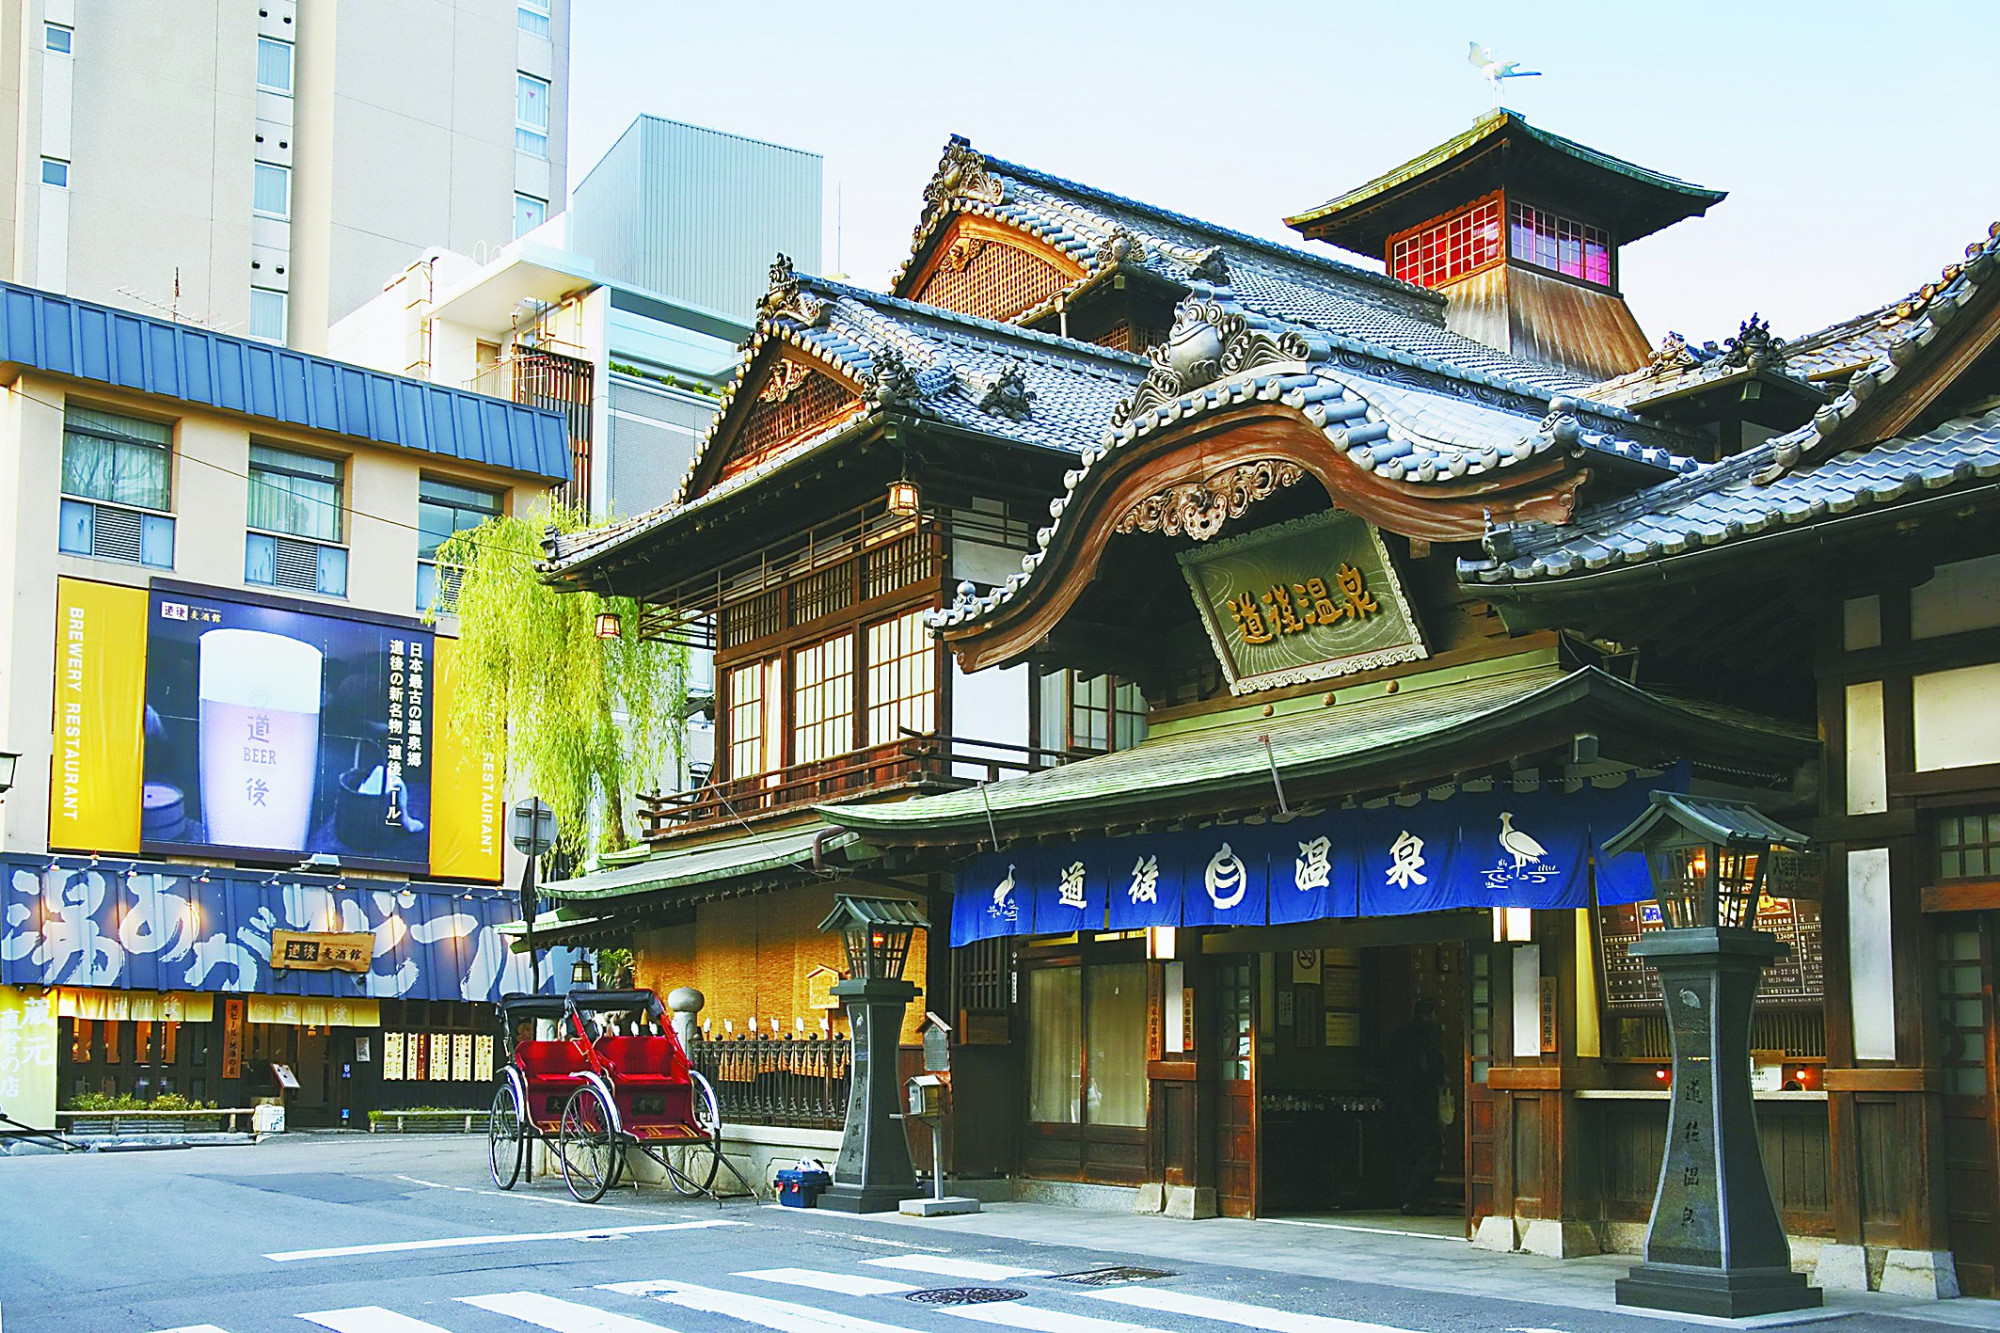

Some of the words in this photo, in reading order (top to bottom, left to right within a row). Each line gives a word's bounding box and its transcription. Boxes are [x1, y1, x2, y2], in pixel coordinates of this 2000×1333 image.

[164, 604, 186, 619] 道後
[1227, 563, 1378, 644] 道後温泉
[67, 606, 85, 693] BREWERY
[247, 714, 270, 744] 道
[385, 639, 405, 827] 道後の新名物「道後ビール」
[406, 641, 424, 769] 日本最古の温泉郷
[62, 702, 81, 821] RESTAURANT
[242, 747, 277, 765] BEER
[246, 777, 270, 807] 後
[479, 750, 495, 857] RESTAURANT
[287, 943, 317, 960] 道後
[321, 946, 363, 961] 麦酒館
[0, 1008, 22, 1099] 直営の店
[21, 995, 55, 1067] 蔵元
